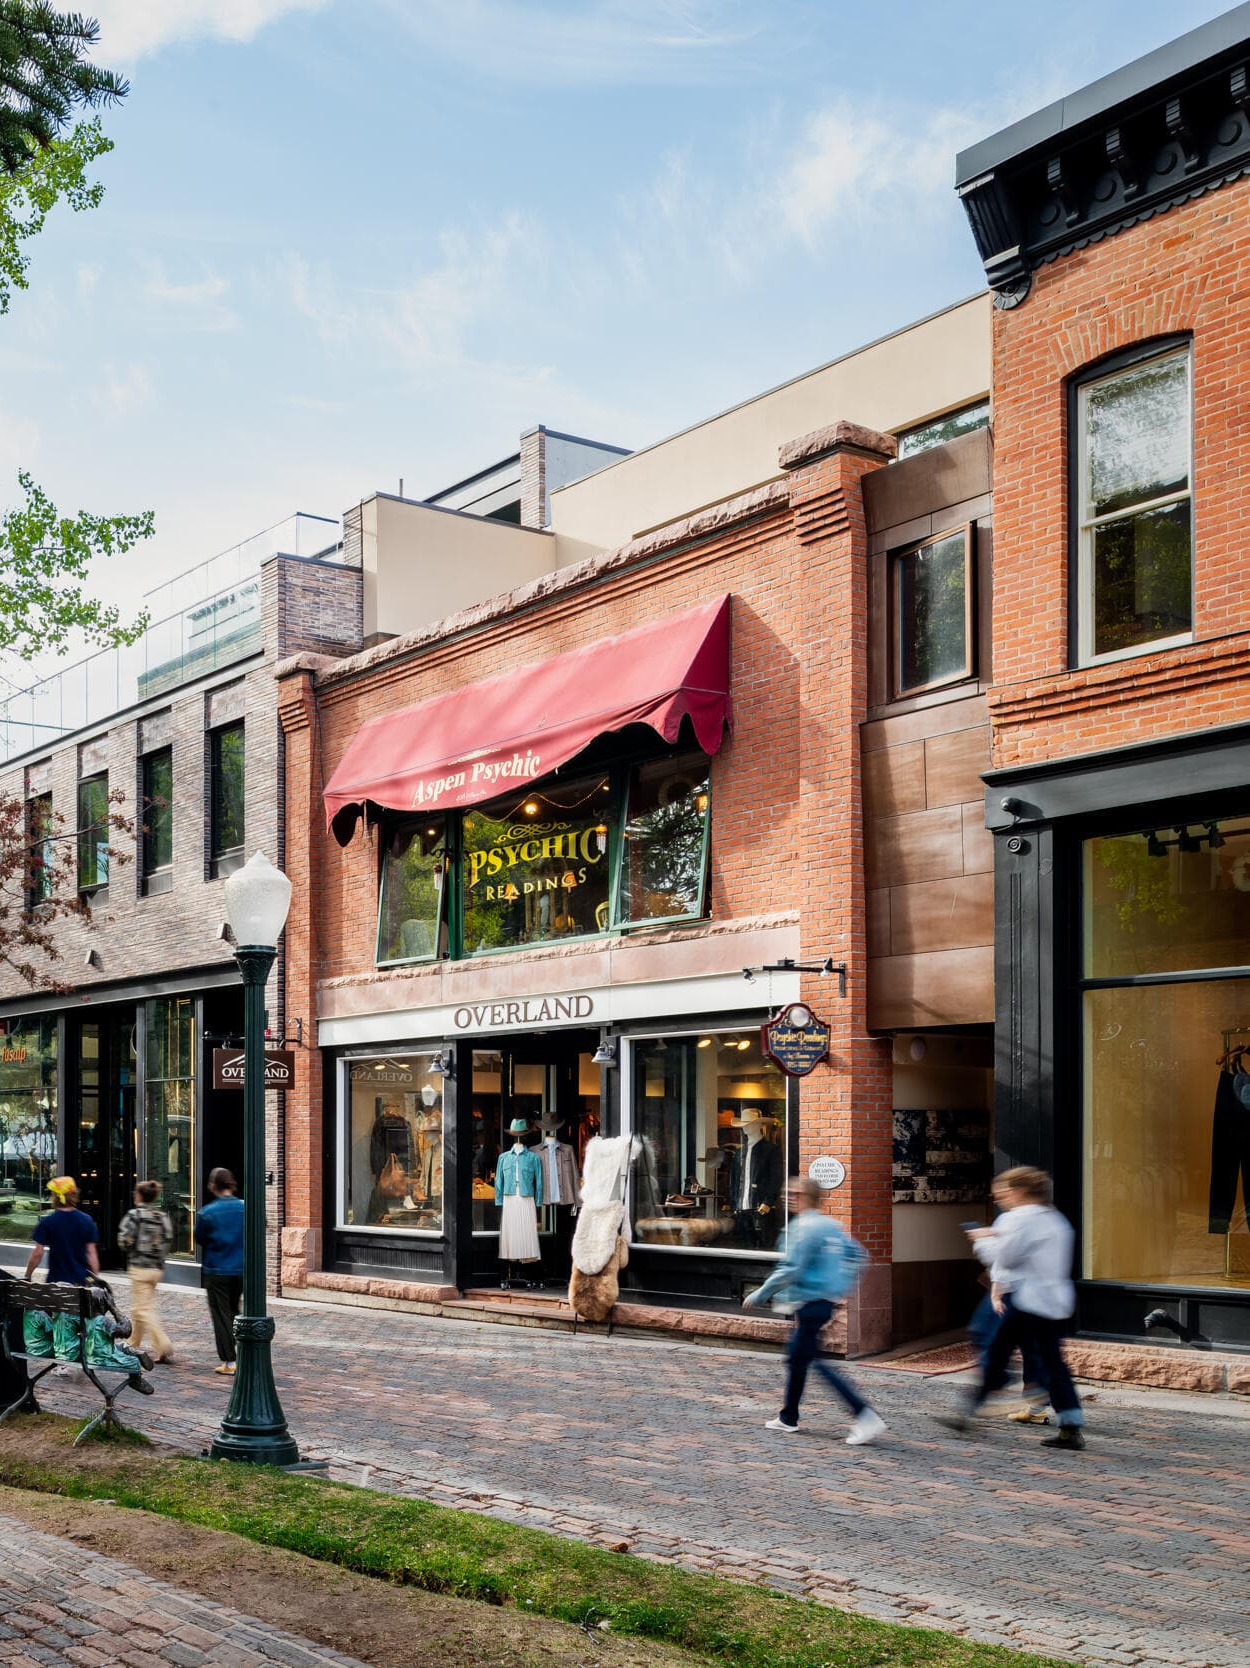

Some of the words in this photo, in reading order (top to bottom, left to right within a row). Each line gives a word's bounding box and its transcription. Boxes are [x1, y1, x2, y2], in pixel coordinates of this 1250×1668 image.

[411, 780, 465, 809] Aspen
[470, 749, 540, 783] Psychic
[469, 826, 602, 889] PSYCHIC
[486, 867, 587, 901] READINGS
[453, 995, 594, 1029] OVERLAND
[221, 1067, 290, 1078] OVEAND
